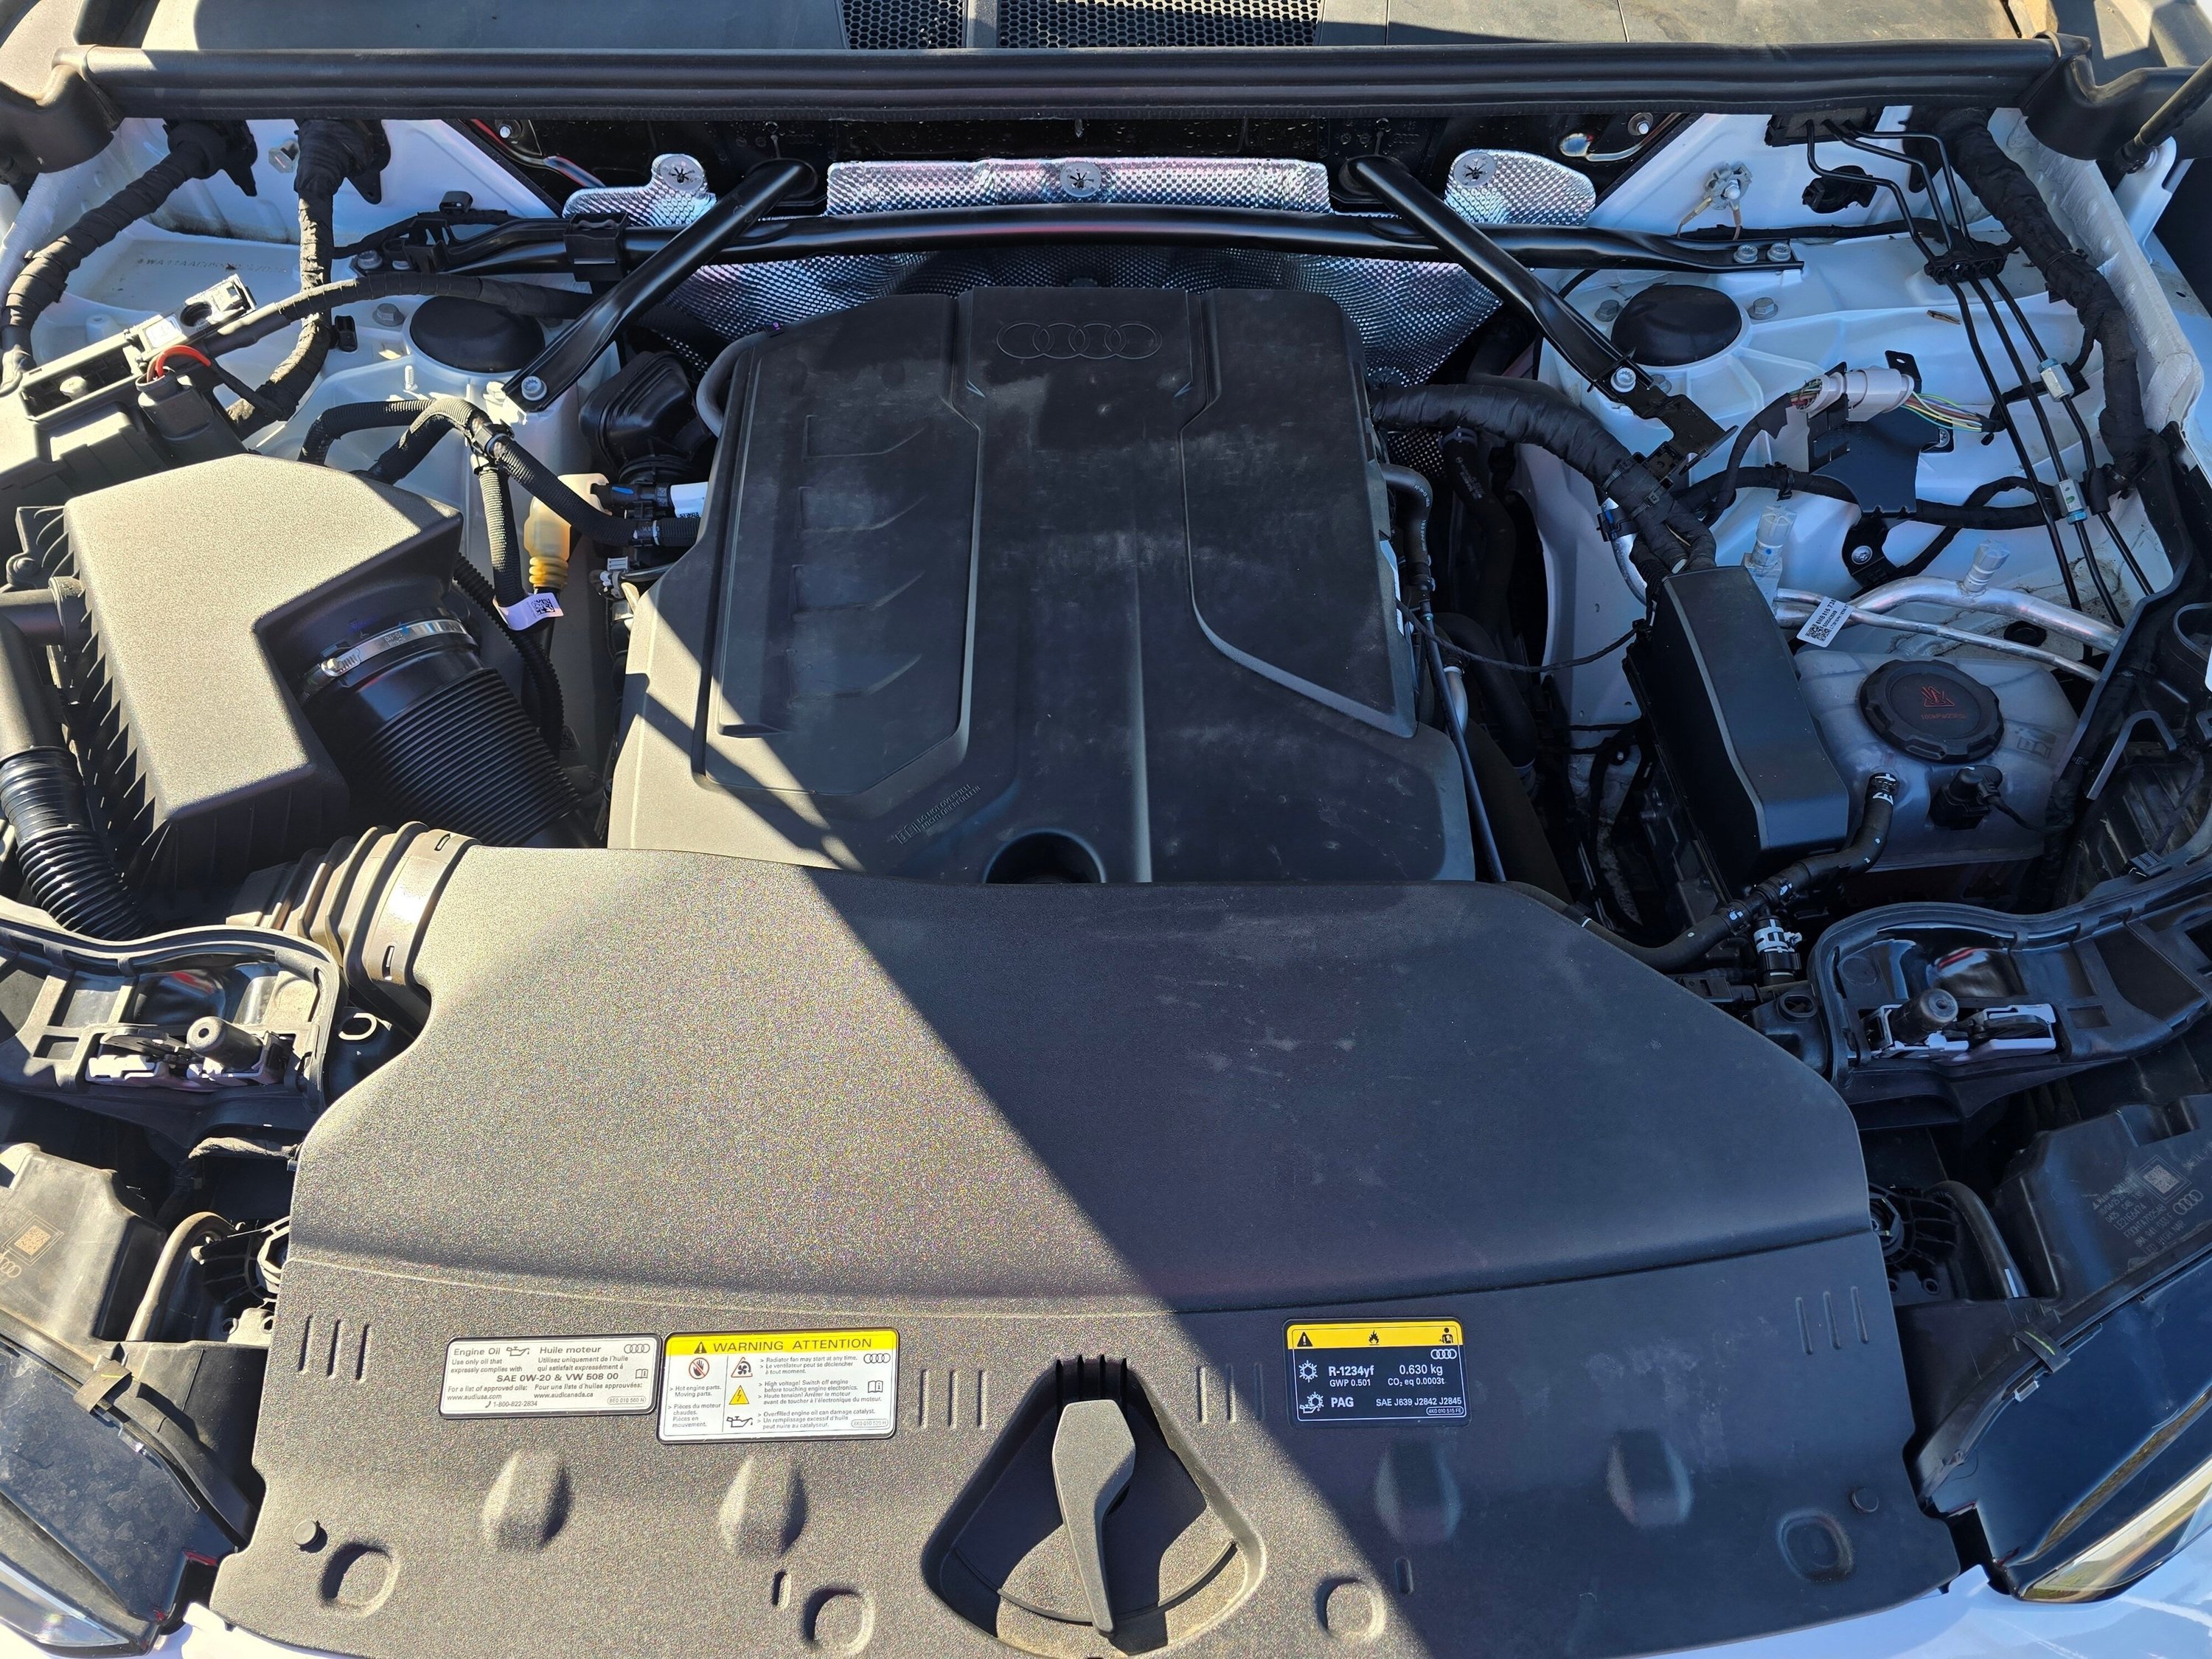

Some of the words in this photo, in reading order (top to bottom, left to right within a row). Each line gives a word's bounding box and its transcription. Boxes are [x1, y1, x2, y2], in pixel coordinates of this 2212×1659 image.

[713, 1342, 784, 1352] WARNING
[793, 1338, 872, 1349] ATTENTION
[454, 1349, 484, 1357] Engine
[1329, 1365, 1374, 1377] R-1234yf
[1399, 1365, 1427, 1374] 0.630
[1430, 1364, 1443, 1376] kg
[1331, 1397, 1354, 1408] PAG
